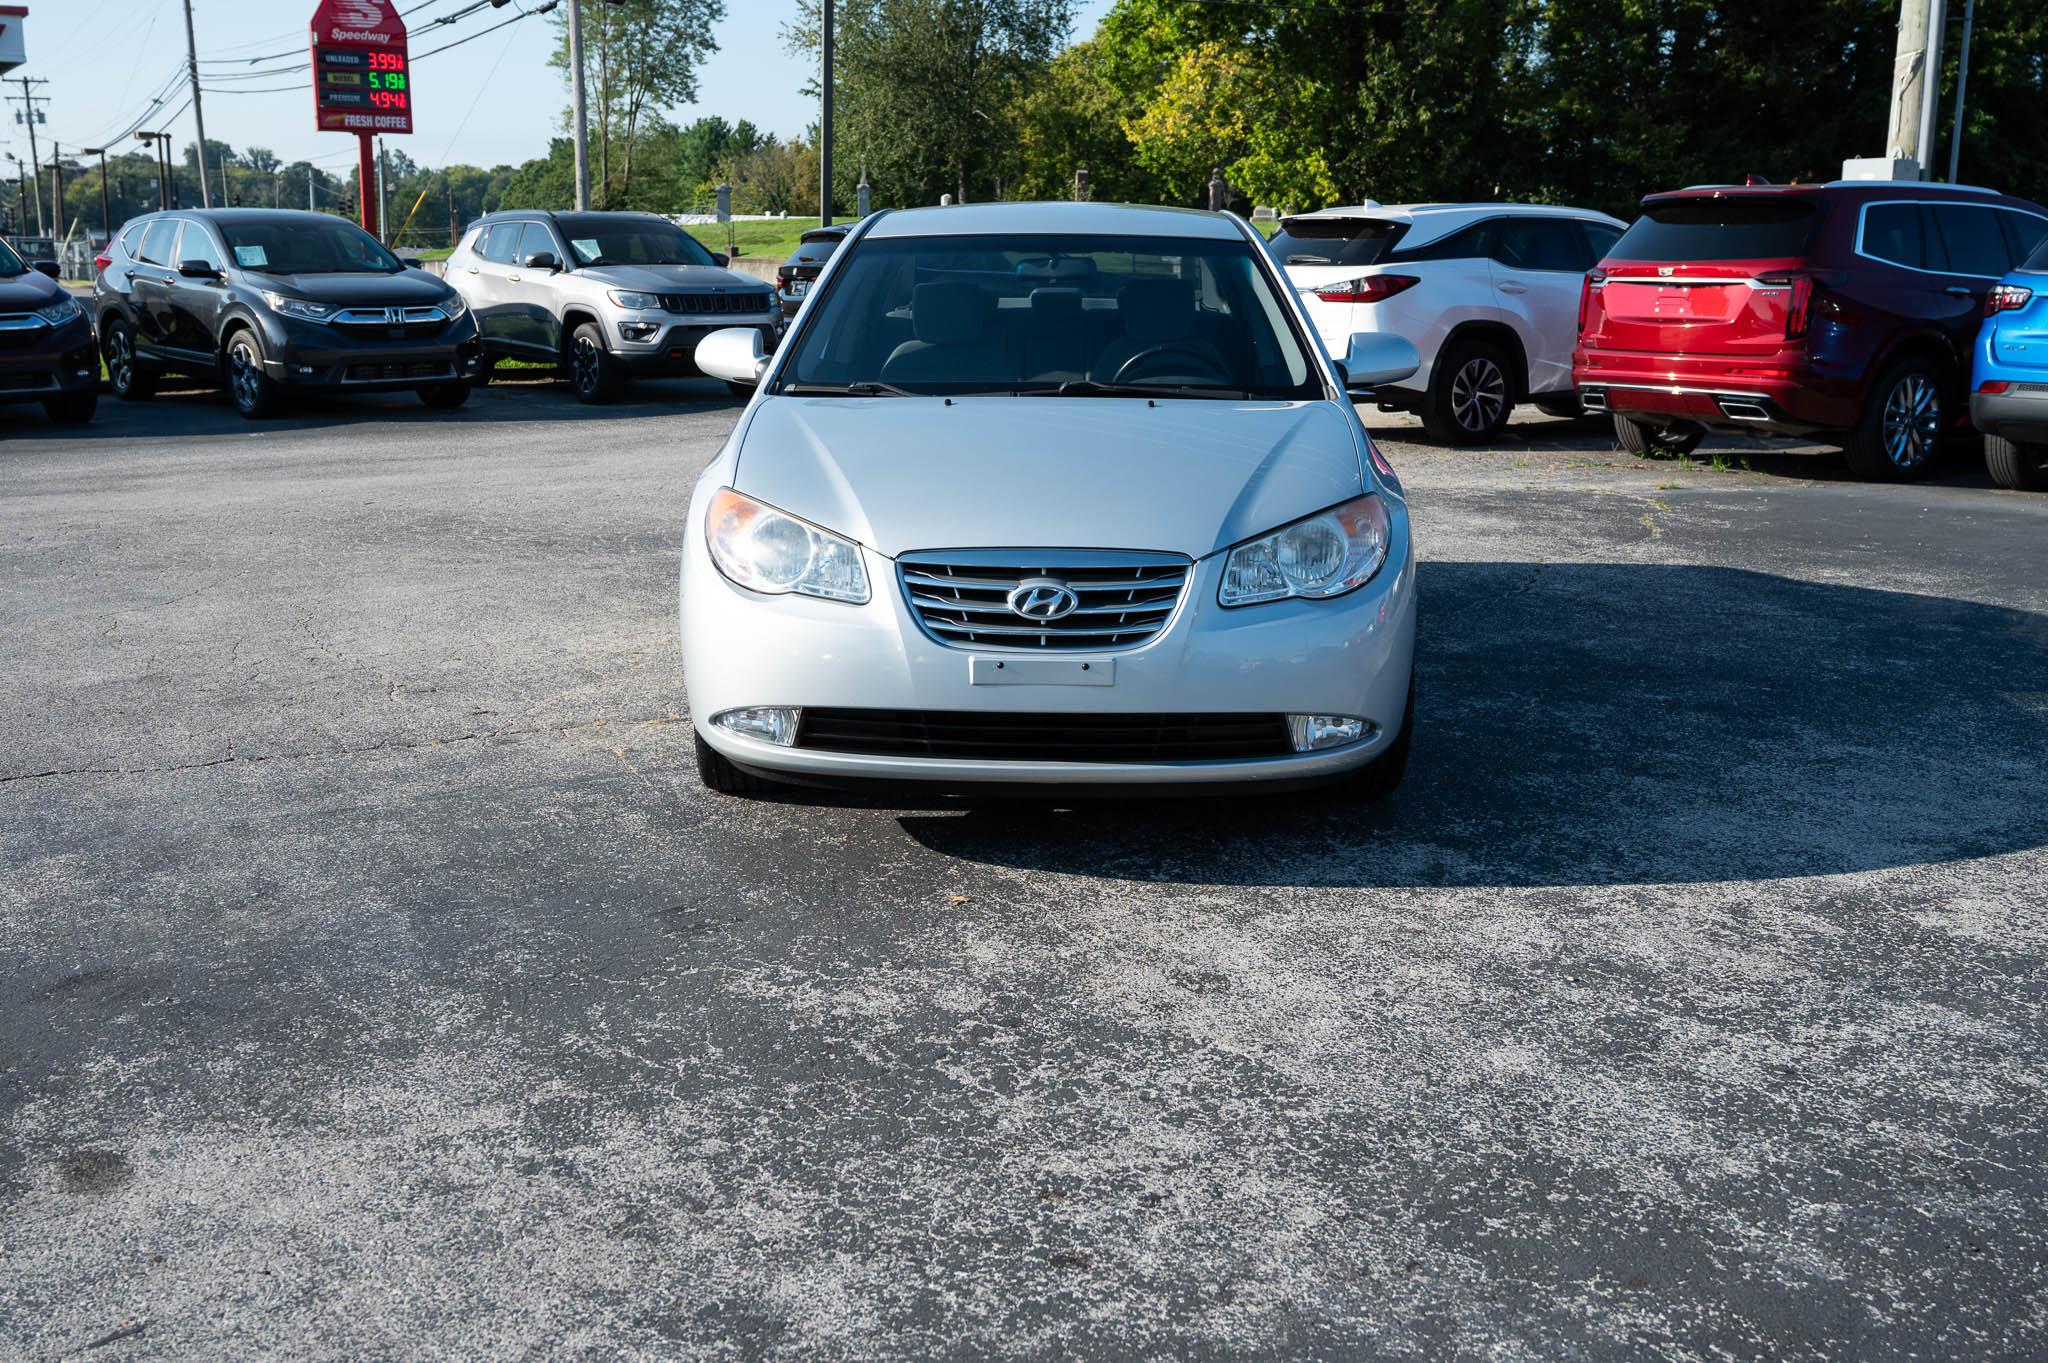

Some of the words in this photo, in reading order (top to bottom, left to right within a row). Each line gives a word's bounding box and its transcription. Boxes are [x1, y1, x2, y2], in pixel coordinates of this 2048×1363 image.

[331, 28, 391, 43] Speedway
[325, 54, 359, 64] UNLEADED
[329, 94, 360, 102] PREMIUM
[344, 115, 373, 126] FRESH
[375, 115, 407, 128] COFFEE
